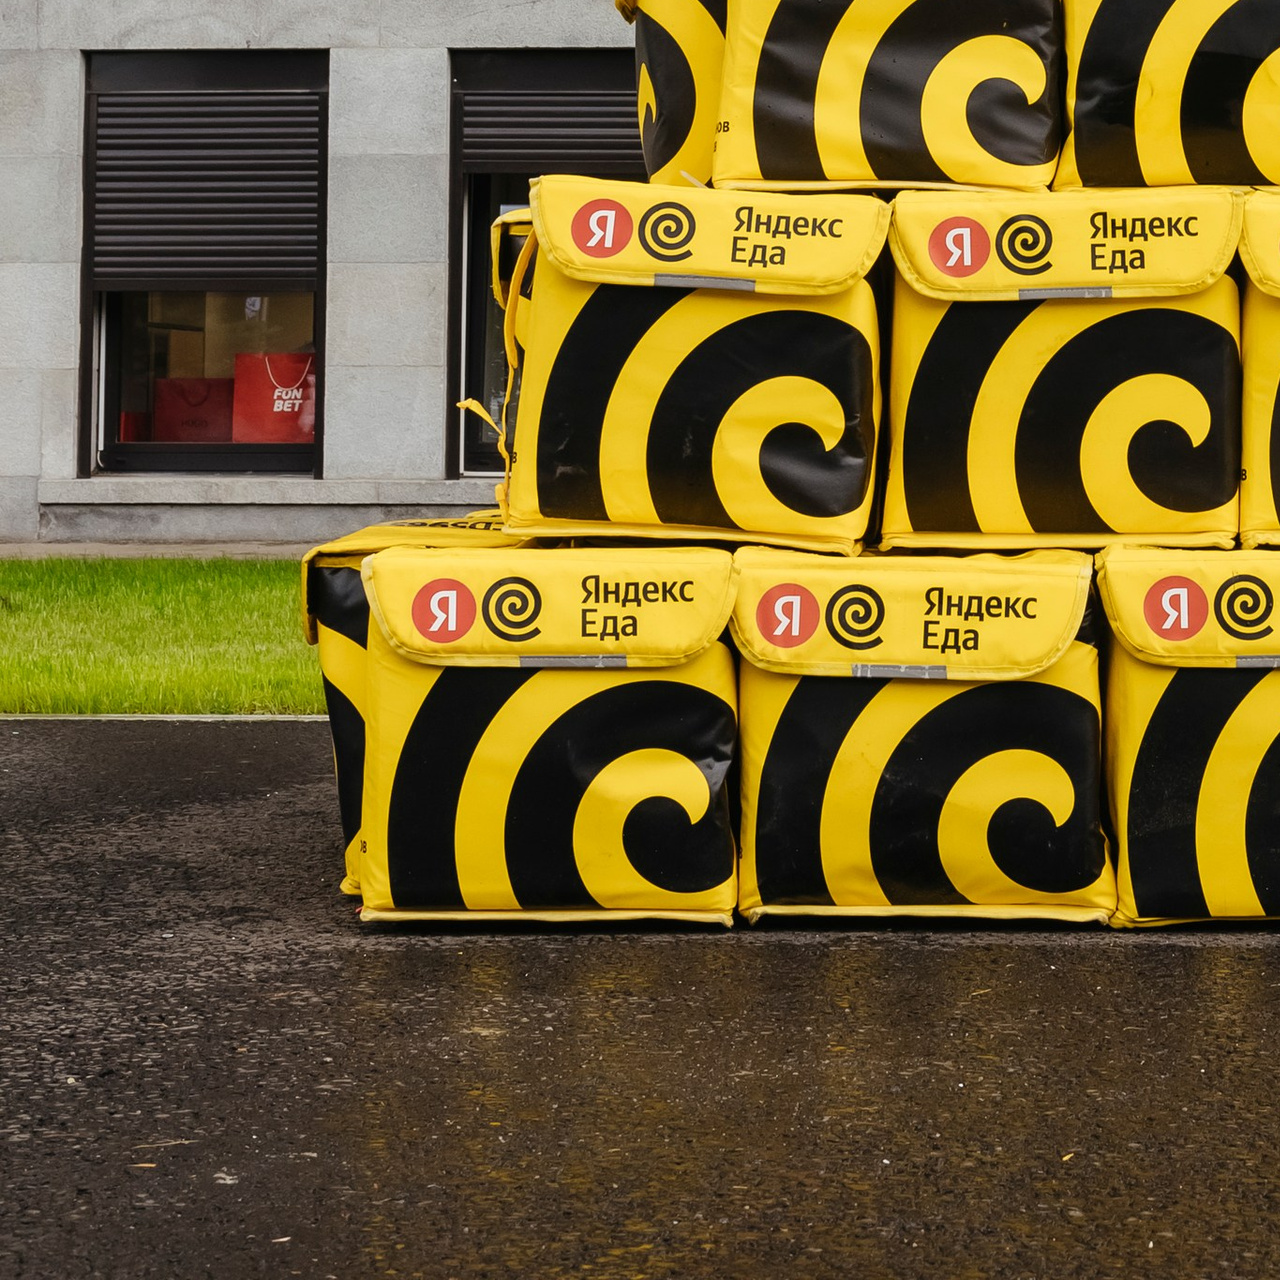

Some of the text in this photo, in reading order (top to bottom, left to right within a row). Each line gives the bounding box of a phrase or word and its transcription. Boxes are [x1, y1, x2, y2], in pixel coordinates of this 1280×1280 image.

[735, 207, 842, 239] Яндекс
[1090, 212, 1198, 242] Яндекс
[731, 237, 785, 267] Еда
[1091, 244, 1145, 273] Еда
[273, 388, 303, 401] FON
[273, 400, 303, 413] BET
[582, 575, 693, 607] Яндекс
[925, 587, 1037, 621] Яндекс
[582, 609, 637, 641] Еда
[923, 621, 978, 654] Еда
